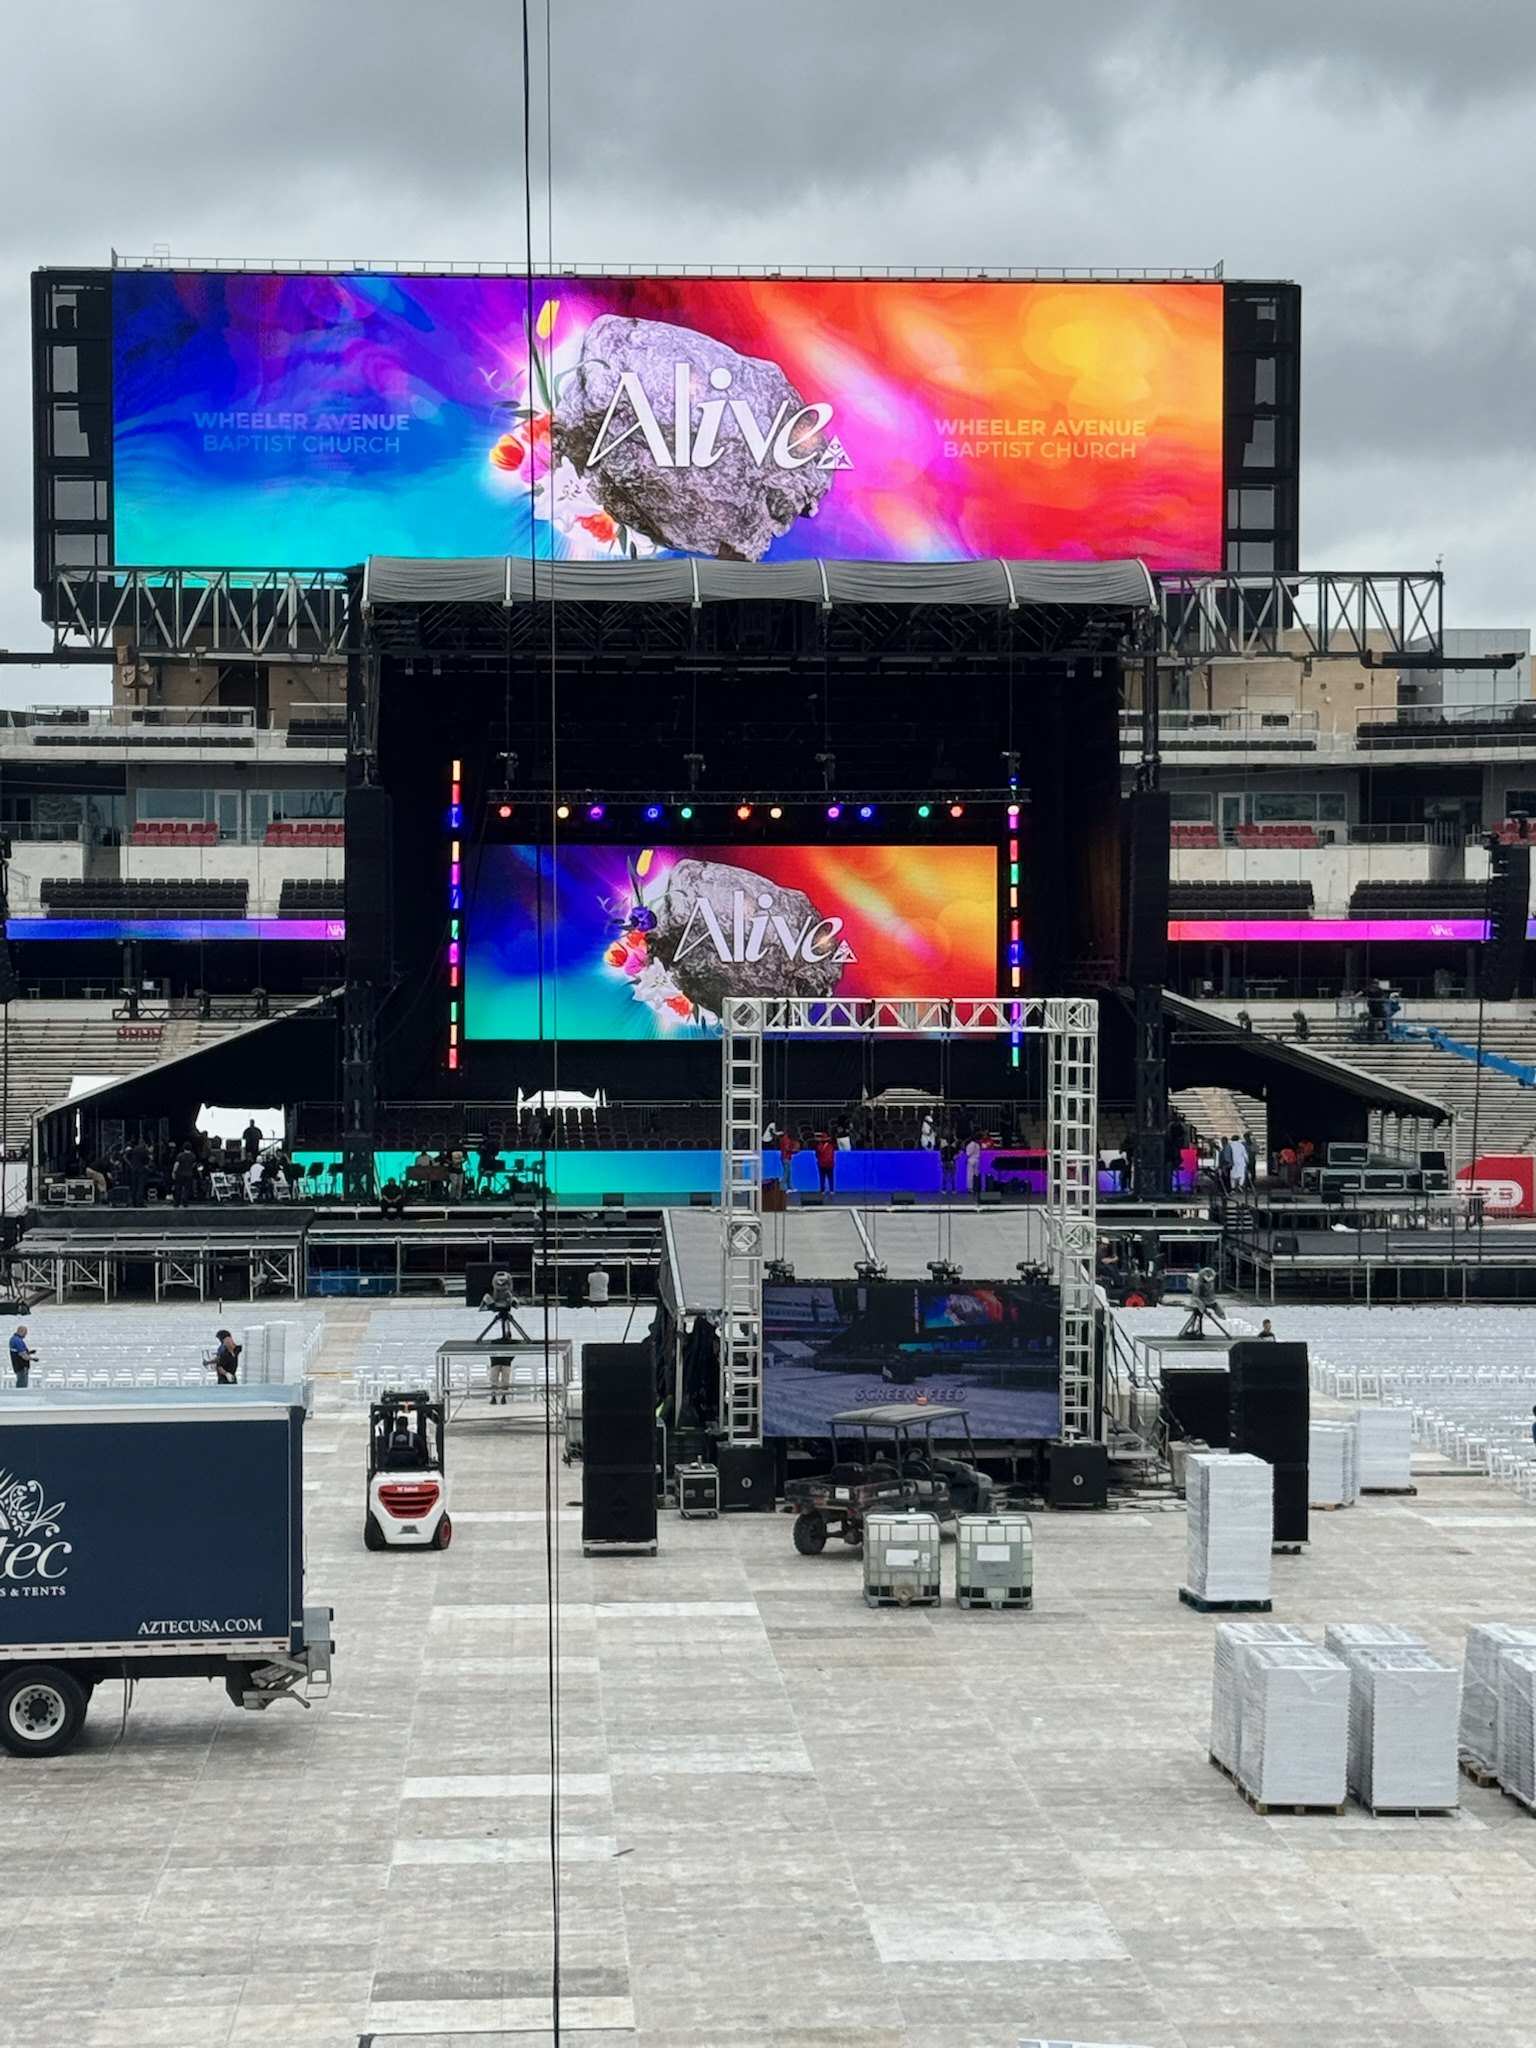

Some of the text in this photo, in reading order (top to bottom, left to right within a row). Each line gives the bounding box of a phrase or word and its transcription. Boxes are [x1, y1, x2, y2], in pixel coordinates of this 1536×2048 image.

[193, 412, 410, 431] WHEELER AVENUE
[586, 362, 834, 470] Alive
[934, 418, 1147, 437] WHEELER AVENUE
[203, 434, 400, 454] BAPTIST CHURCH
[943, 441, 1137, 459] BAPTIST CHURCH
[673, 890, 844, 963] Alive
[10, 1587, 20, 1597] &
[22, 1586, 66, 1597] TENTS
[138, 1618, 263, 1635] AZTECUSA.COM
